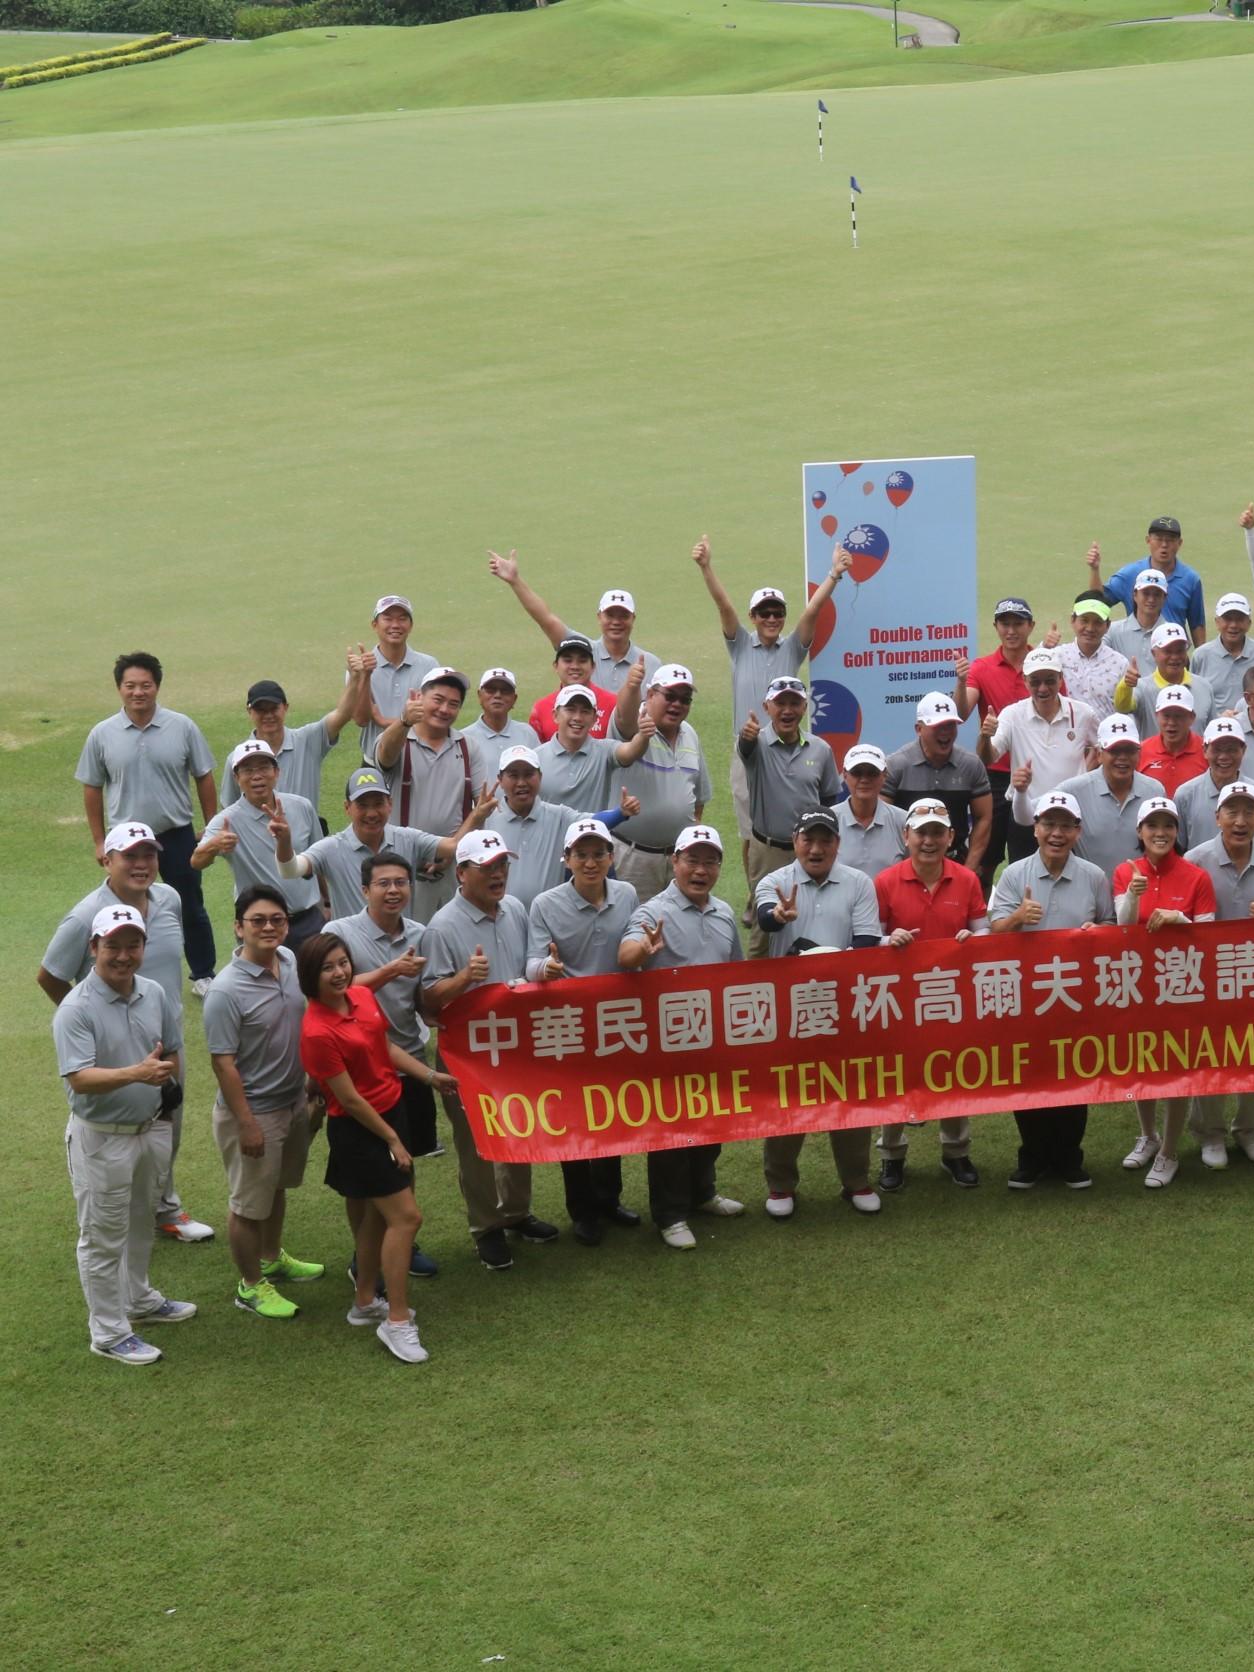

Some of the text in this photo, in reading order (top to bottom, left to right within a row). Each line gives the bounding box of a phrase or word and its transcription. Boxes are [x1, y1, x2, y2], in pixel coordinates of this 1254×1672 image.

[870, 623, 968, 644] Double Tenth
[843, 651, 874, 668] Golf
[888, 671, 909, 682] SICC
[910, 670, 937, 680] Island
[885, 695, 903, 704] 20th
[478, 1089, 567, 1138] ROC
[582, 1069, 753, 1132] DOUBLE
[770, 1055, 904, 1109] TENTH
[923, 1042, 1030, 1093] GOLF
